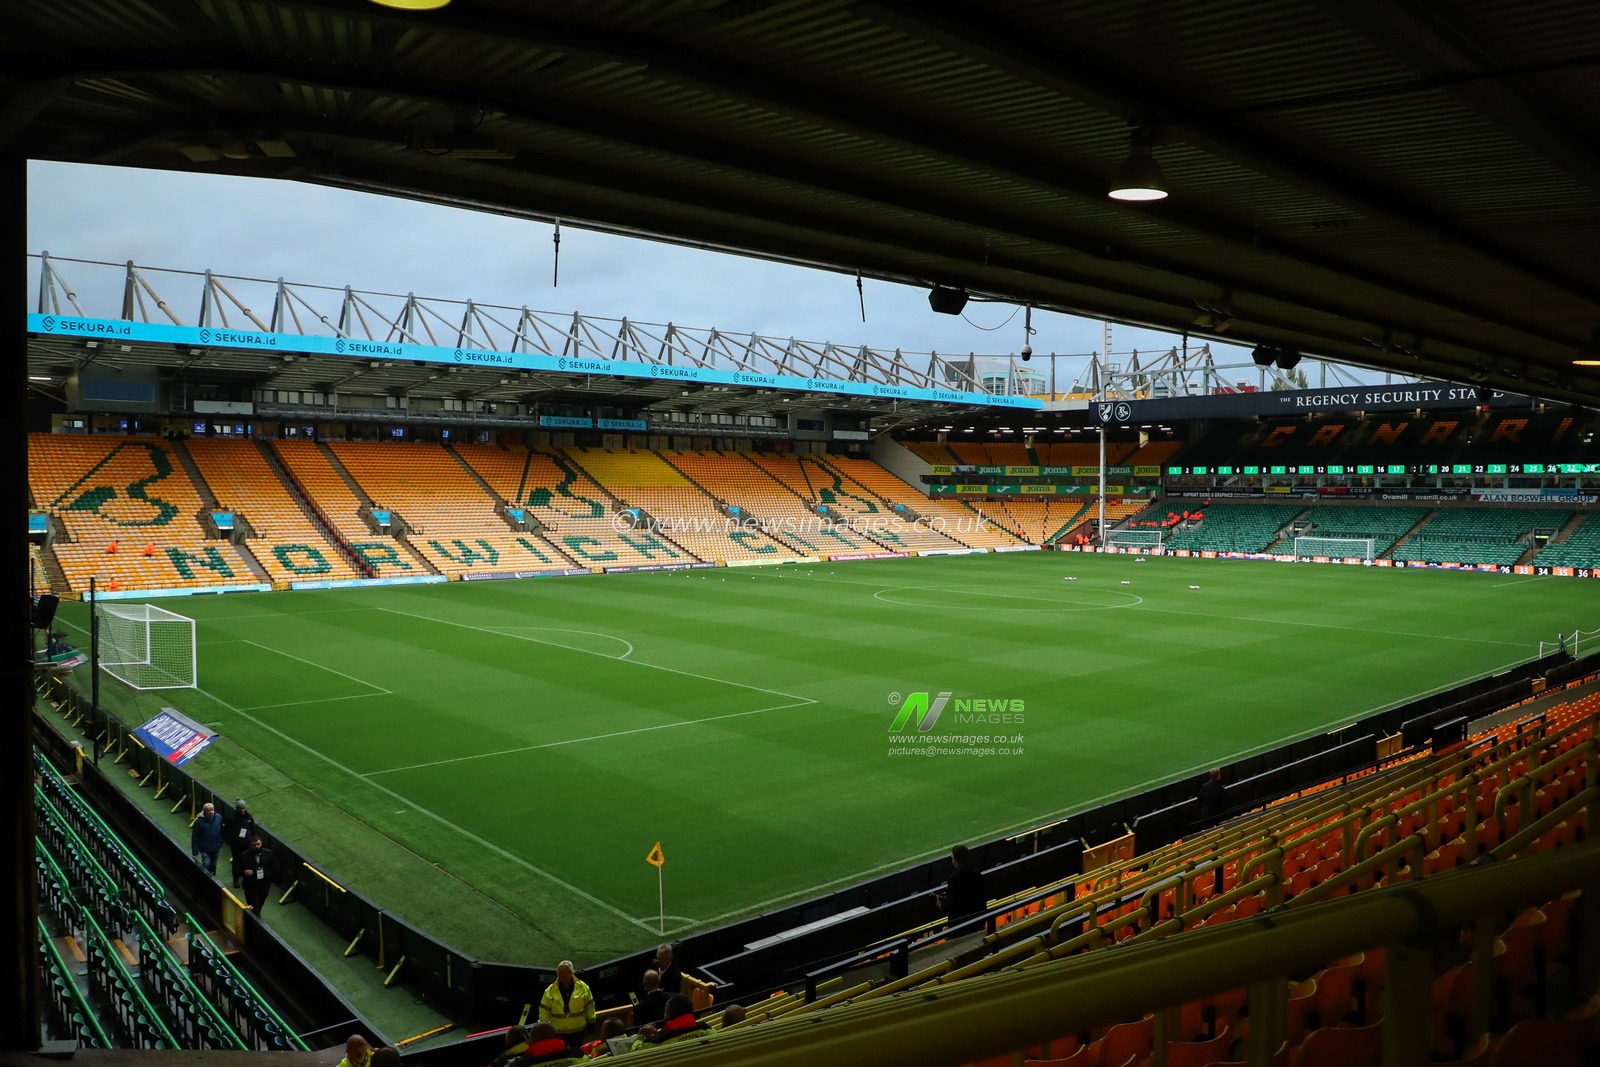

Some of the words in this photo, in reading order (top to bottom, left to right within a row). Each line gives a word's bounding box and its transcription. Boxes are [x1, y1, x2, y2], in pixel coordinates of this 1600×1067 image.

[60, 320, 130, 335] SEKURA.id
[215, 333, 276, 346] SEKURA.id
[349, 343, 402, 355] SEKURA.id
[466, 352, 513, 364] SEKURA.id
[568, 361, 610, 371] SEKURA.id
[660, 368, 698, 378] SEKURA.id
[741, 375, 775, 384] SEKURA.id
[814, 381, 844, 390] SEKURA.id
[880, 387, 907, 396] SEKURA.id
[1296, 394, 1359, 406] REGENCY
[1365, 390, 1442, 404] SECURITY
[1449, 388, 1504, 400] STAD
